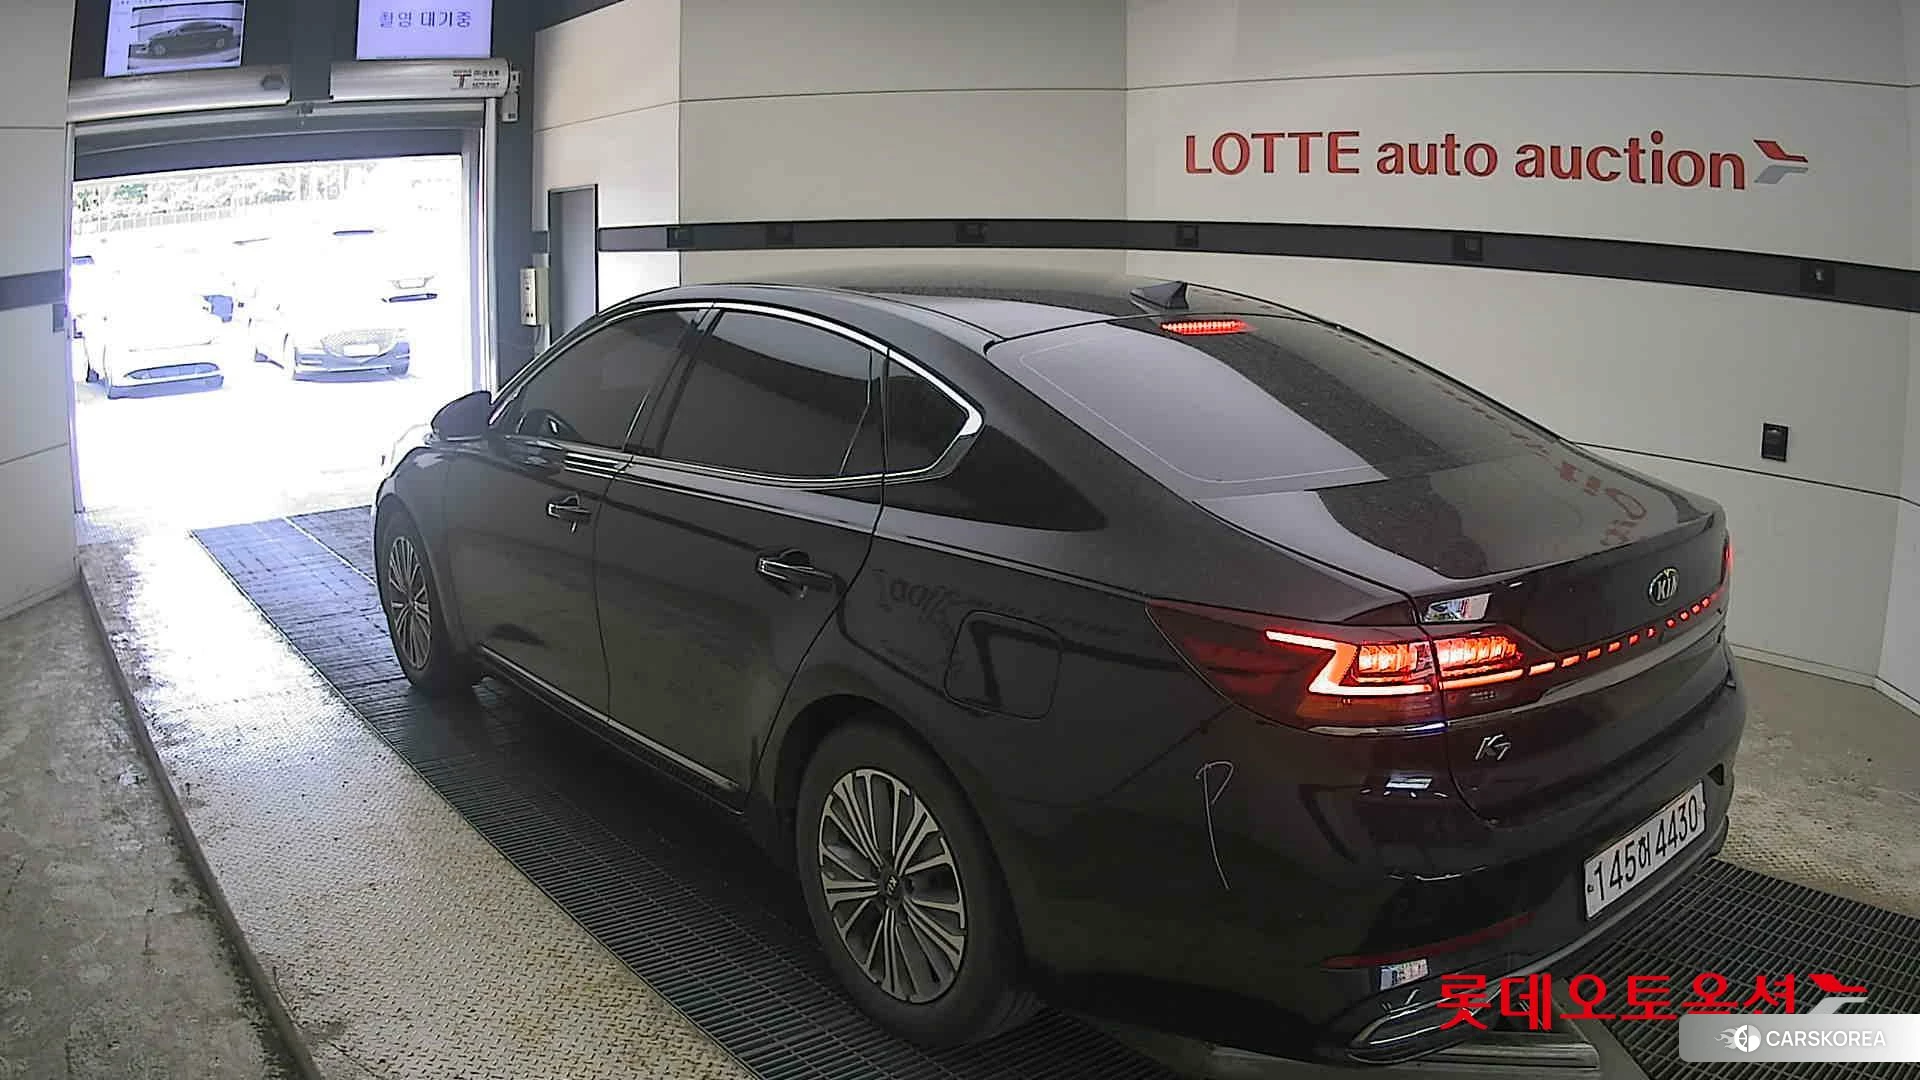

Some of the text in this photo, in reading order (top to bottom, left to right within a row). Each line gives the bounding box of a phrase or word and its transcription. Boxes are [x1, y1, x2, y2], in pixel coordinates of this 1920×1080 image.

[420, 11, 471, 28] 대기중
[1185, 131, 1745, 190] LOTTE auto auction
[1475, 734, 1512, 761] K7
[1655, 794, 1698, 857] 4430
